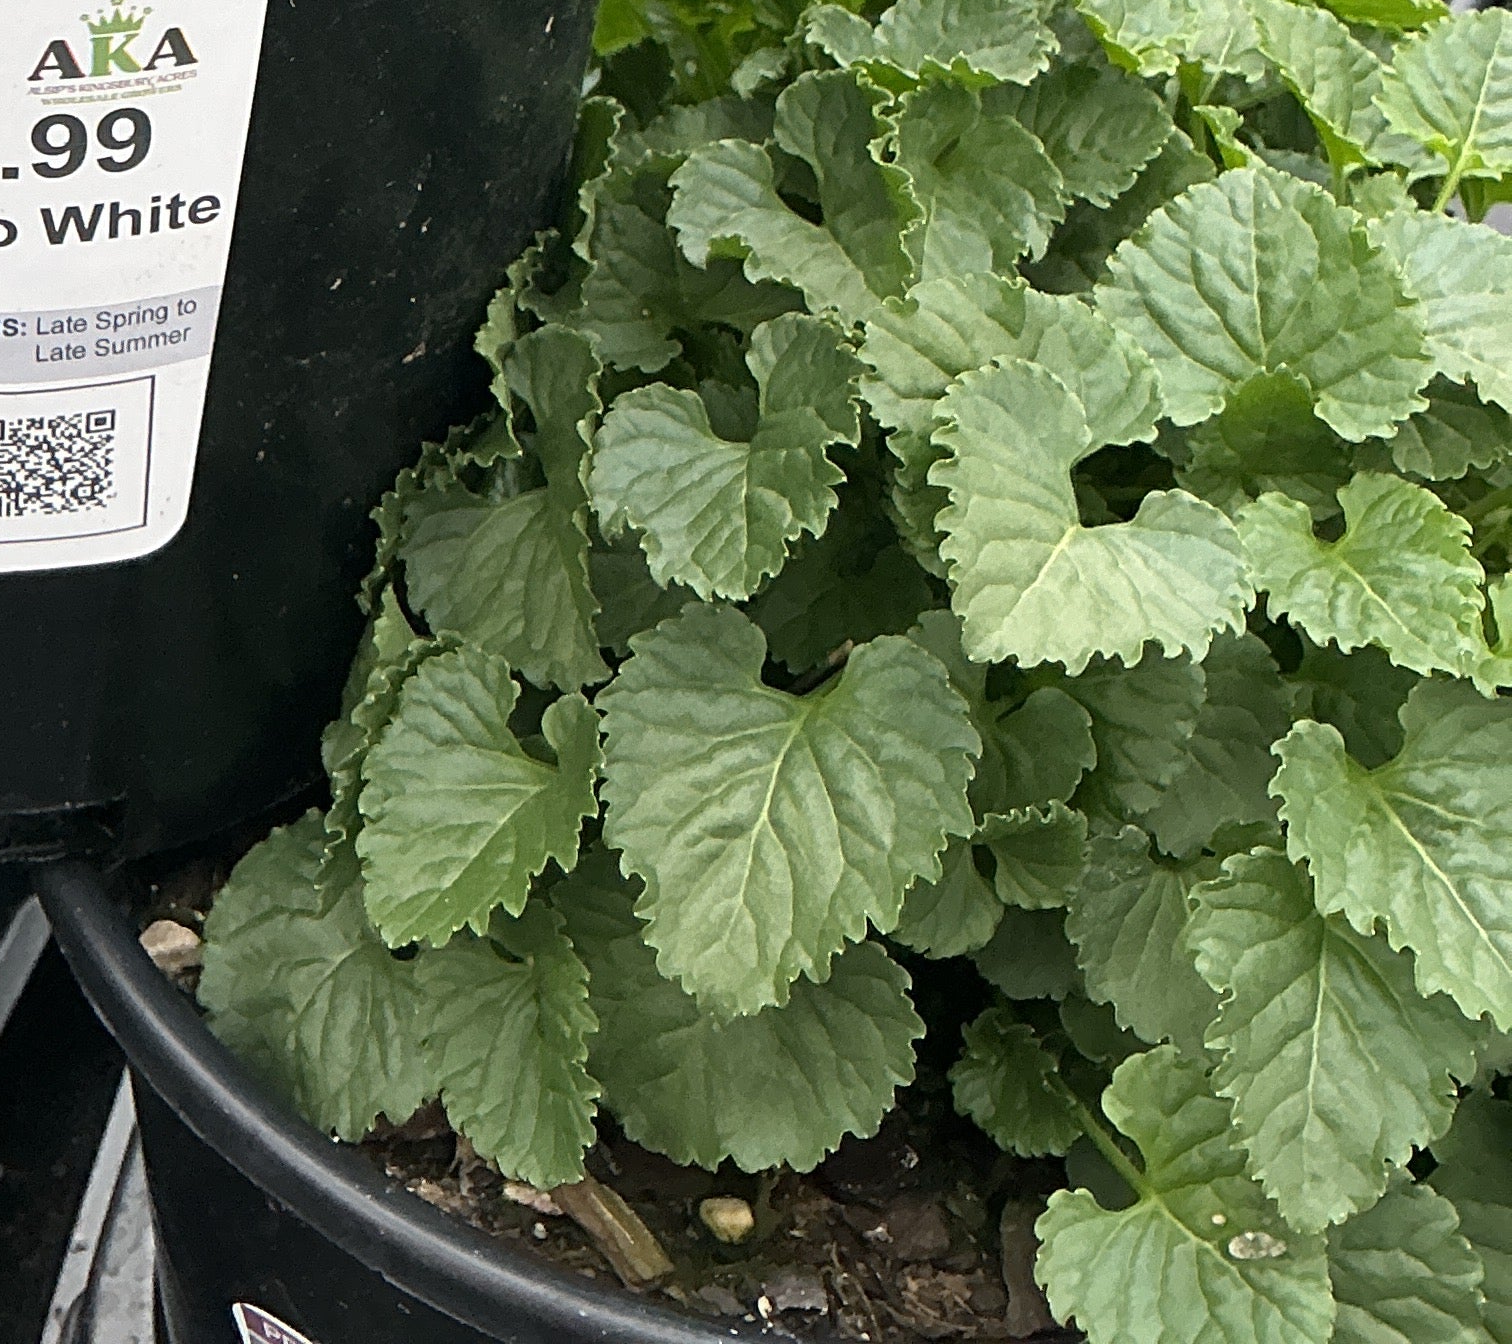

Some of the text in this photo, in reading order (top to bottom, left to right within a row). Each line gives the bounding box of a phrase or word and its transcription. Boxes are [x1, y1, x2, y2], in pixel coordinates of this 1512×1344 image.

[27, 27, 198, 81] AKA
[41, 192, 221, 245] White
[36, 315, 88, 337] Late
[95, 305, 169, 333] Spring
[176, 298, 197, 318] to
[35, 325, 192, 363] Late Summer
